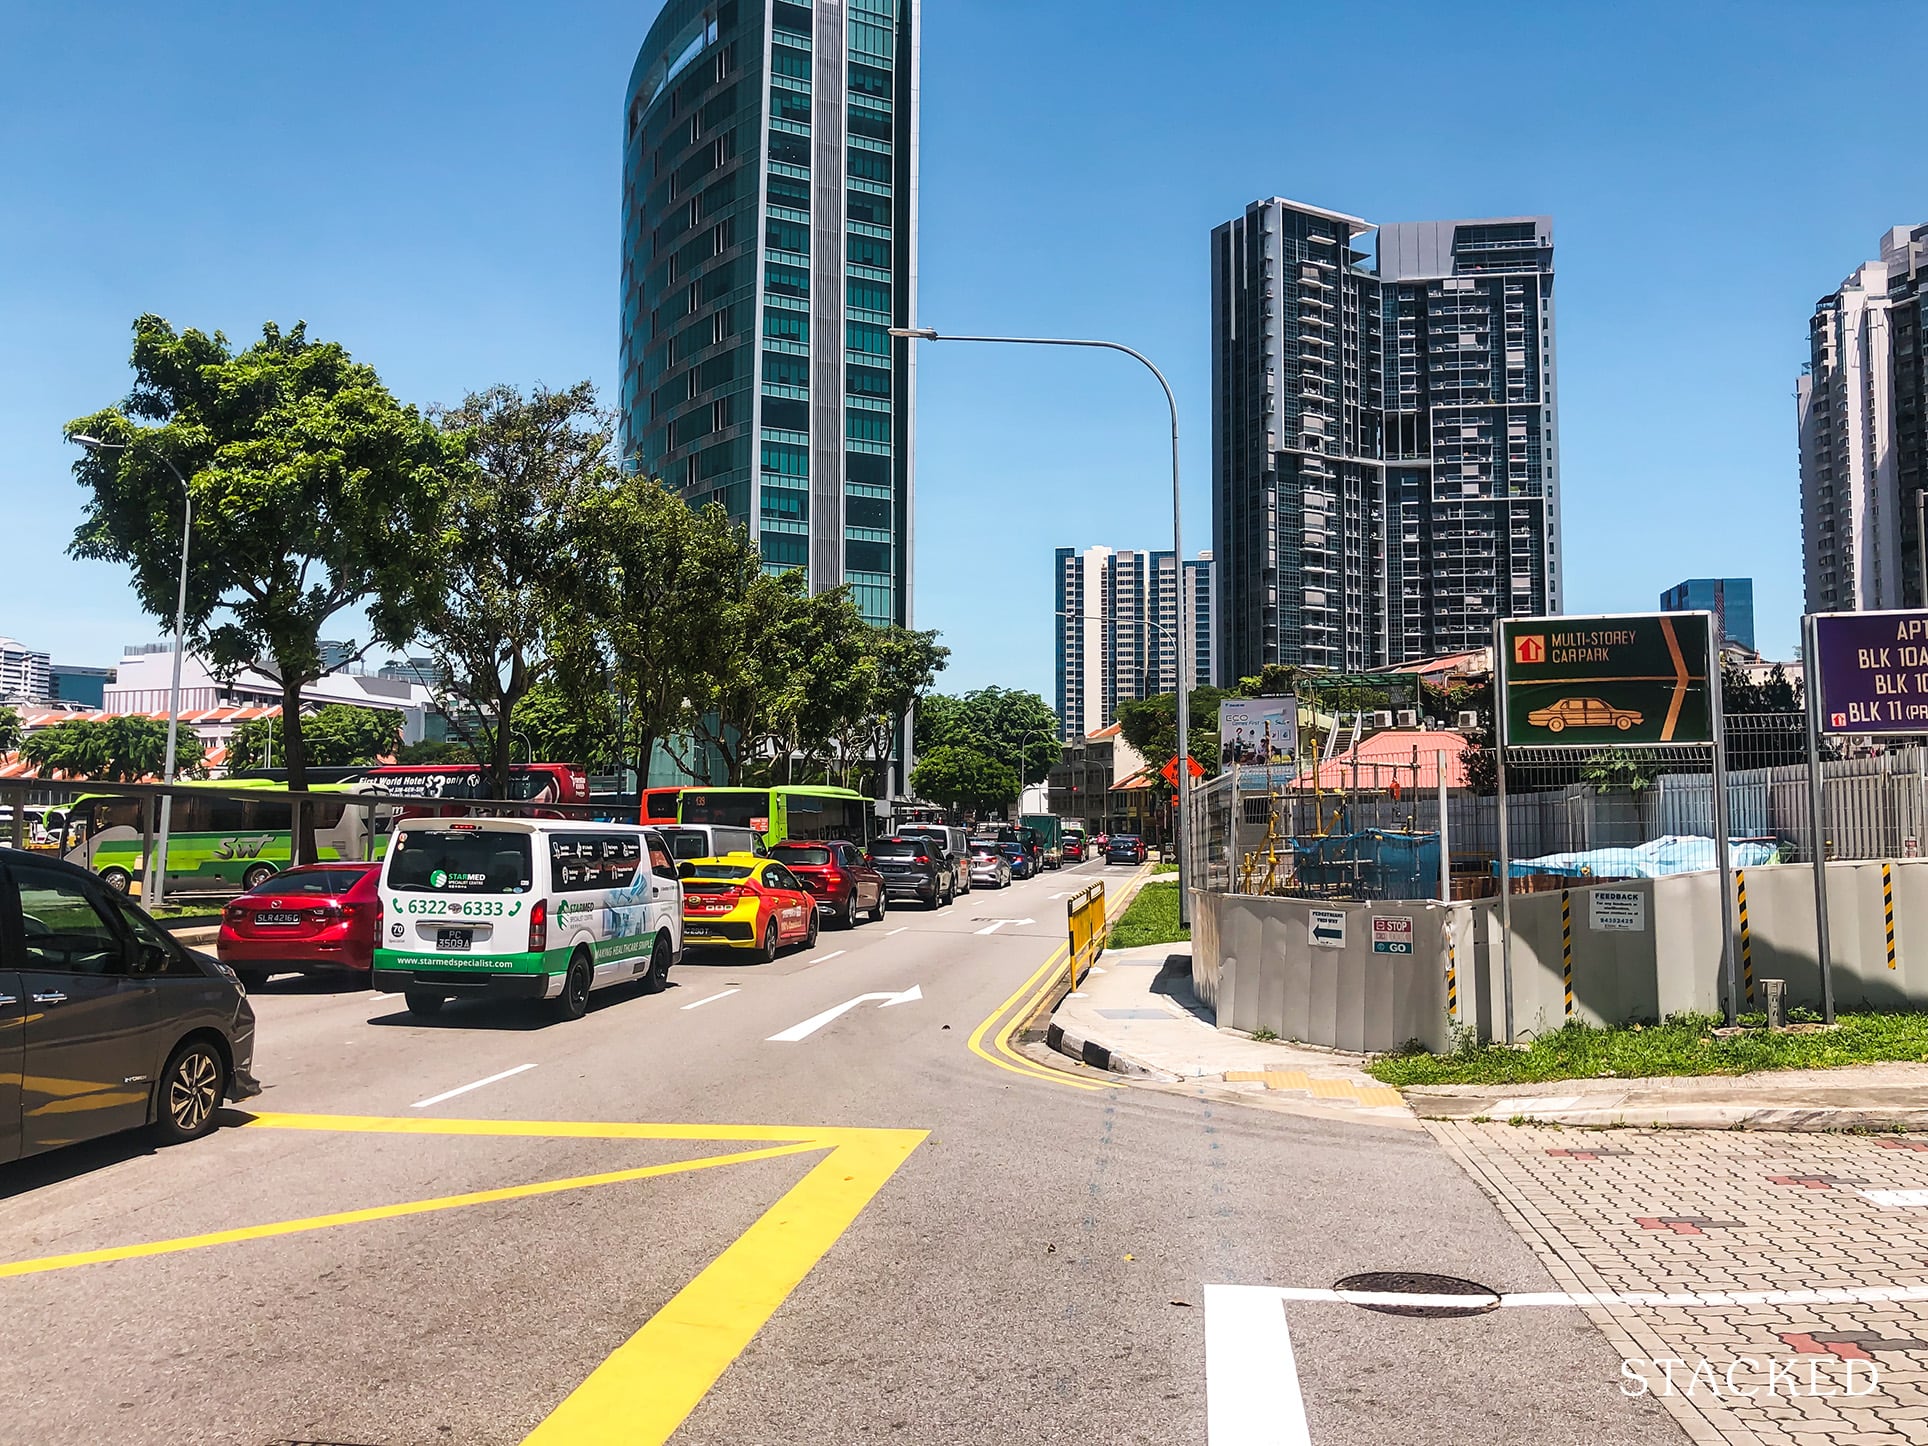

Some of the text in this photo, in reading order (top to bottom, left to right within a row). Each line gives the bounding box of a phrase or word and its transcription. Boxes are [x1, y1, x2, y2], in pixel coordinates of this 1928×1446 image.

[1551, 630, 1637, 647] MULTI-STOREY
[1858, 647, 1891, 669] BLK
[1875, 673, 1908, 695] BLK
[1848, 701, 1881, 723] BLK
[1887, 700, 1902, 721] 11
[1225, 714, 1249, 722] ECO
[379, 776, 402, 786] World
[403, 776, 426, 786] Hotel
[425, 775, 446, 799] $3
[446, 776, 464, 786] only
[448, 873, 486, 881] STARMED
[1595, 892, 1638, 900] FEEDBACK
[408, 899, 503, 916] 6322 6333
[392, 925, 403, 933] 70
[1386, 920, 1408, 932] STOP
[448, 930, 462, 939] PC
[1389, 943, 1407, 953] GO
[397, 956, 514, 969] www.starmedspecialist.com
